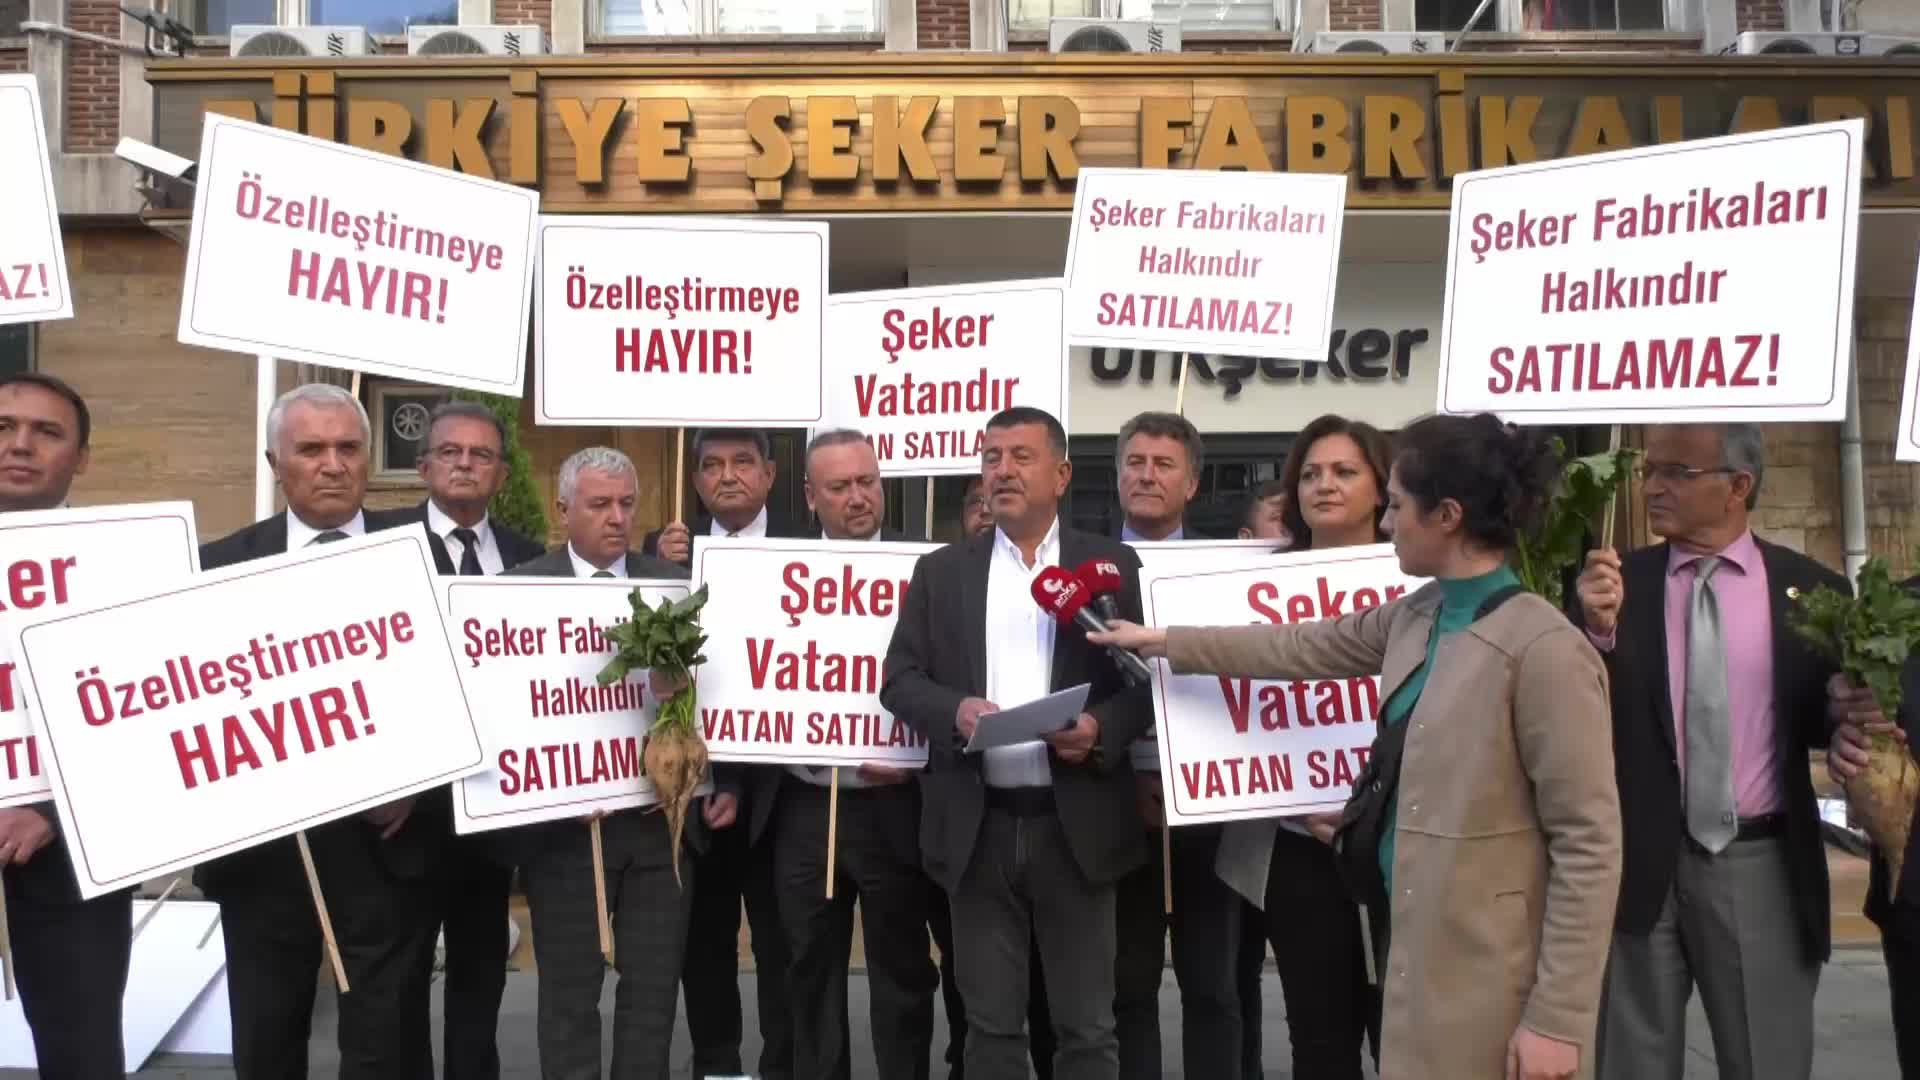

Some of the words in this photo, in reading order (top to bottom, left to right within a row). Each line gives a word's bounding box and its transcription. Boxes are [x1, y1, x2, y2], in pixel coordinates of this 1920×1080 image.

[201, 71, 692, 184] ÜRKİYE
[745, 95, 1081, 201] ŞEKER
[236, 172, 504, 273] Özelleştirmeye
[1089, 197, 1167, 232] Şeker
[1176, 200, 1326, 234] Fabrikaları
[1471, 211, 1577, 263] Şeker
[1593, 181, 1828, 241] Fabrikaları
[289, 249, 447, 323] HAYIR!
[1138, 245, 1262, 278] Halkındır
[1541, 261, 1727, 314] Halkındır
[566, 266, 800, 321] Özelleştirmeye
[1097, 292, 1293, 335] SATILAMAZ!
[616, 328, 751, 374] HAYIR!
[881, 307, 995, 364] Şeker
[1489, 335, 1779, 394] SATILAMAZ!
[854, 367, 1019, 418] Vatandır
[0, 556, 77, 612] er
[75, 610, 415, 727] Özelleştirmeye
[464, 617, 547, 667] Şeker
[746, 637, 887, 694] Vatan
[530, 676, 646, 718] Halkındır
[170, 680, 377, 790] HAYIR!
[702, 708, 793, 744] VATAN
[1180, 753, 1293, 800] VATAN
